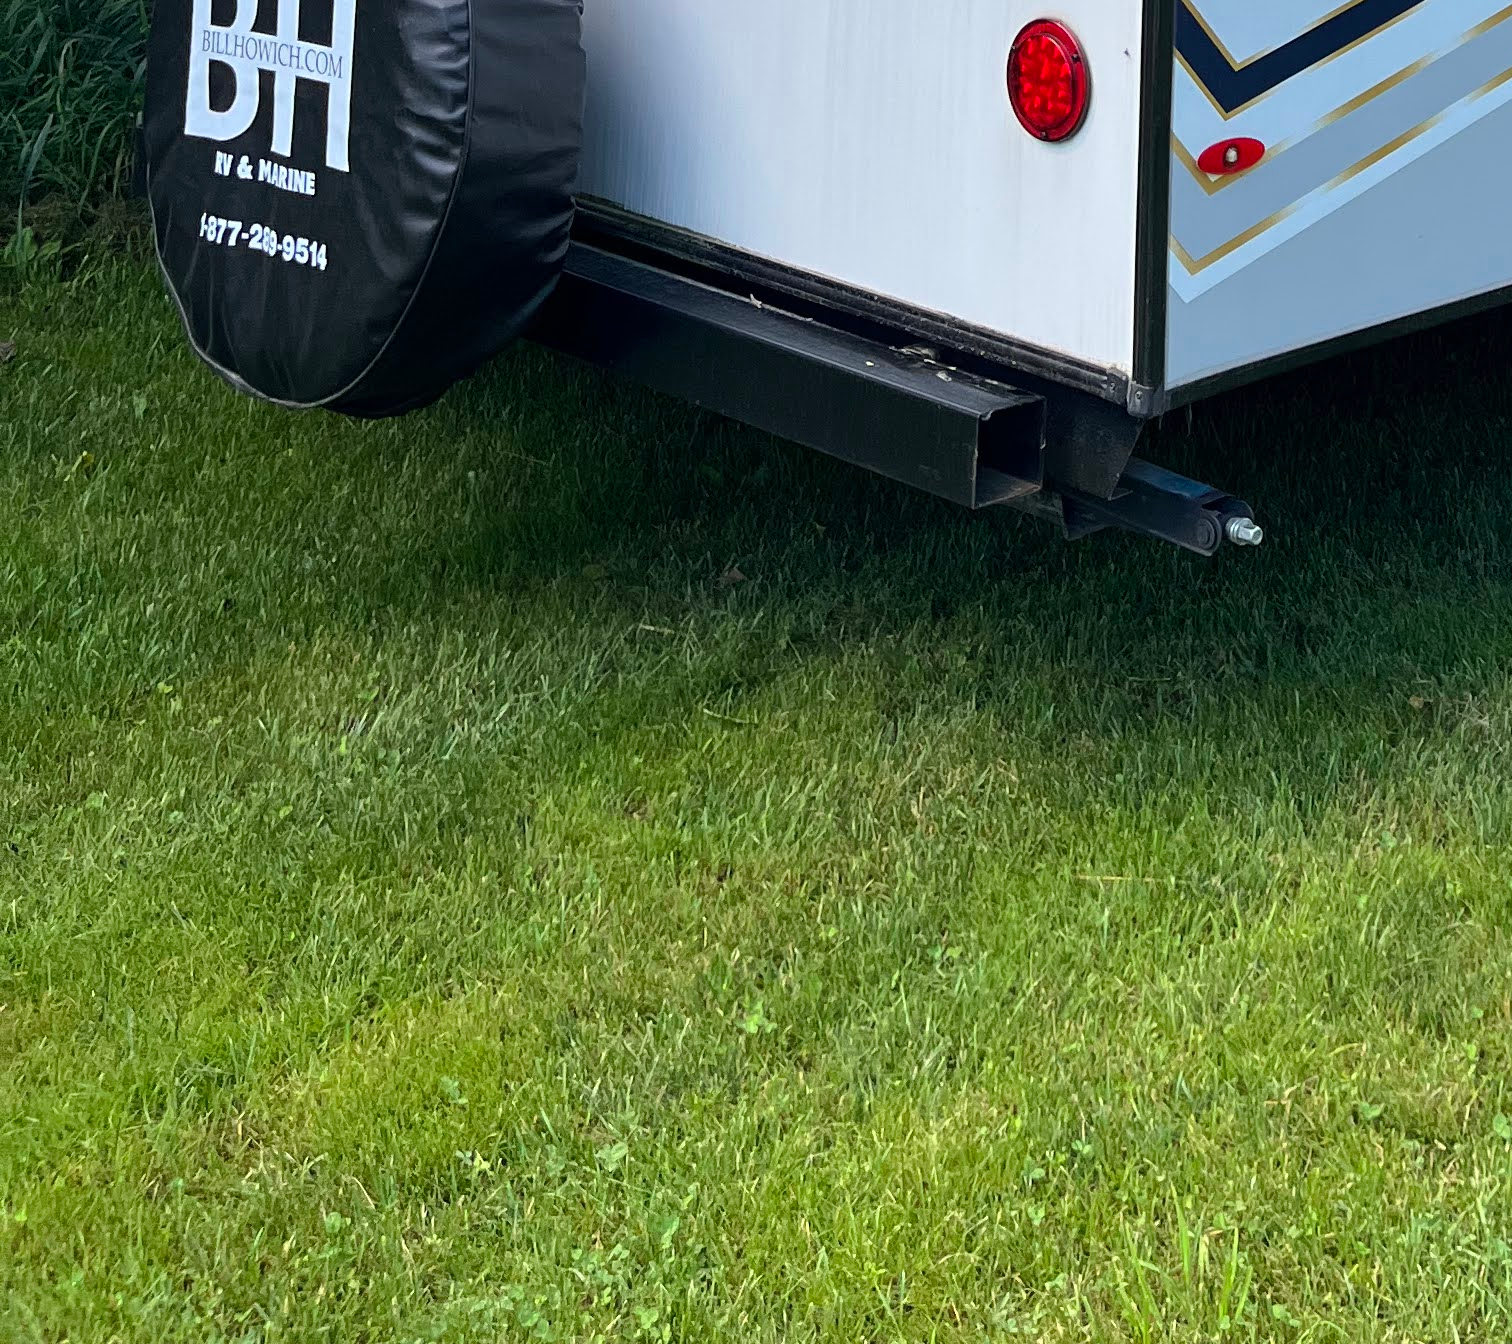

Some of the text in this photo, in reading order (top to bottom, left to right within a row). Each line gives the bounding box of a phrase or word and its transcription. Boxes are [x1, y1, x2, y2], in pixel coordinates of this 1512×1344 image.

[202, 30, 343, 79] BILLHOWICH.COM
[214, 150, 316, 195] RV & MARINE
